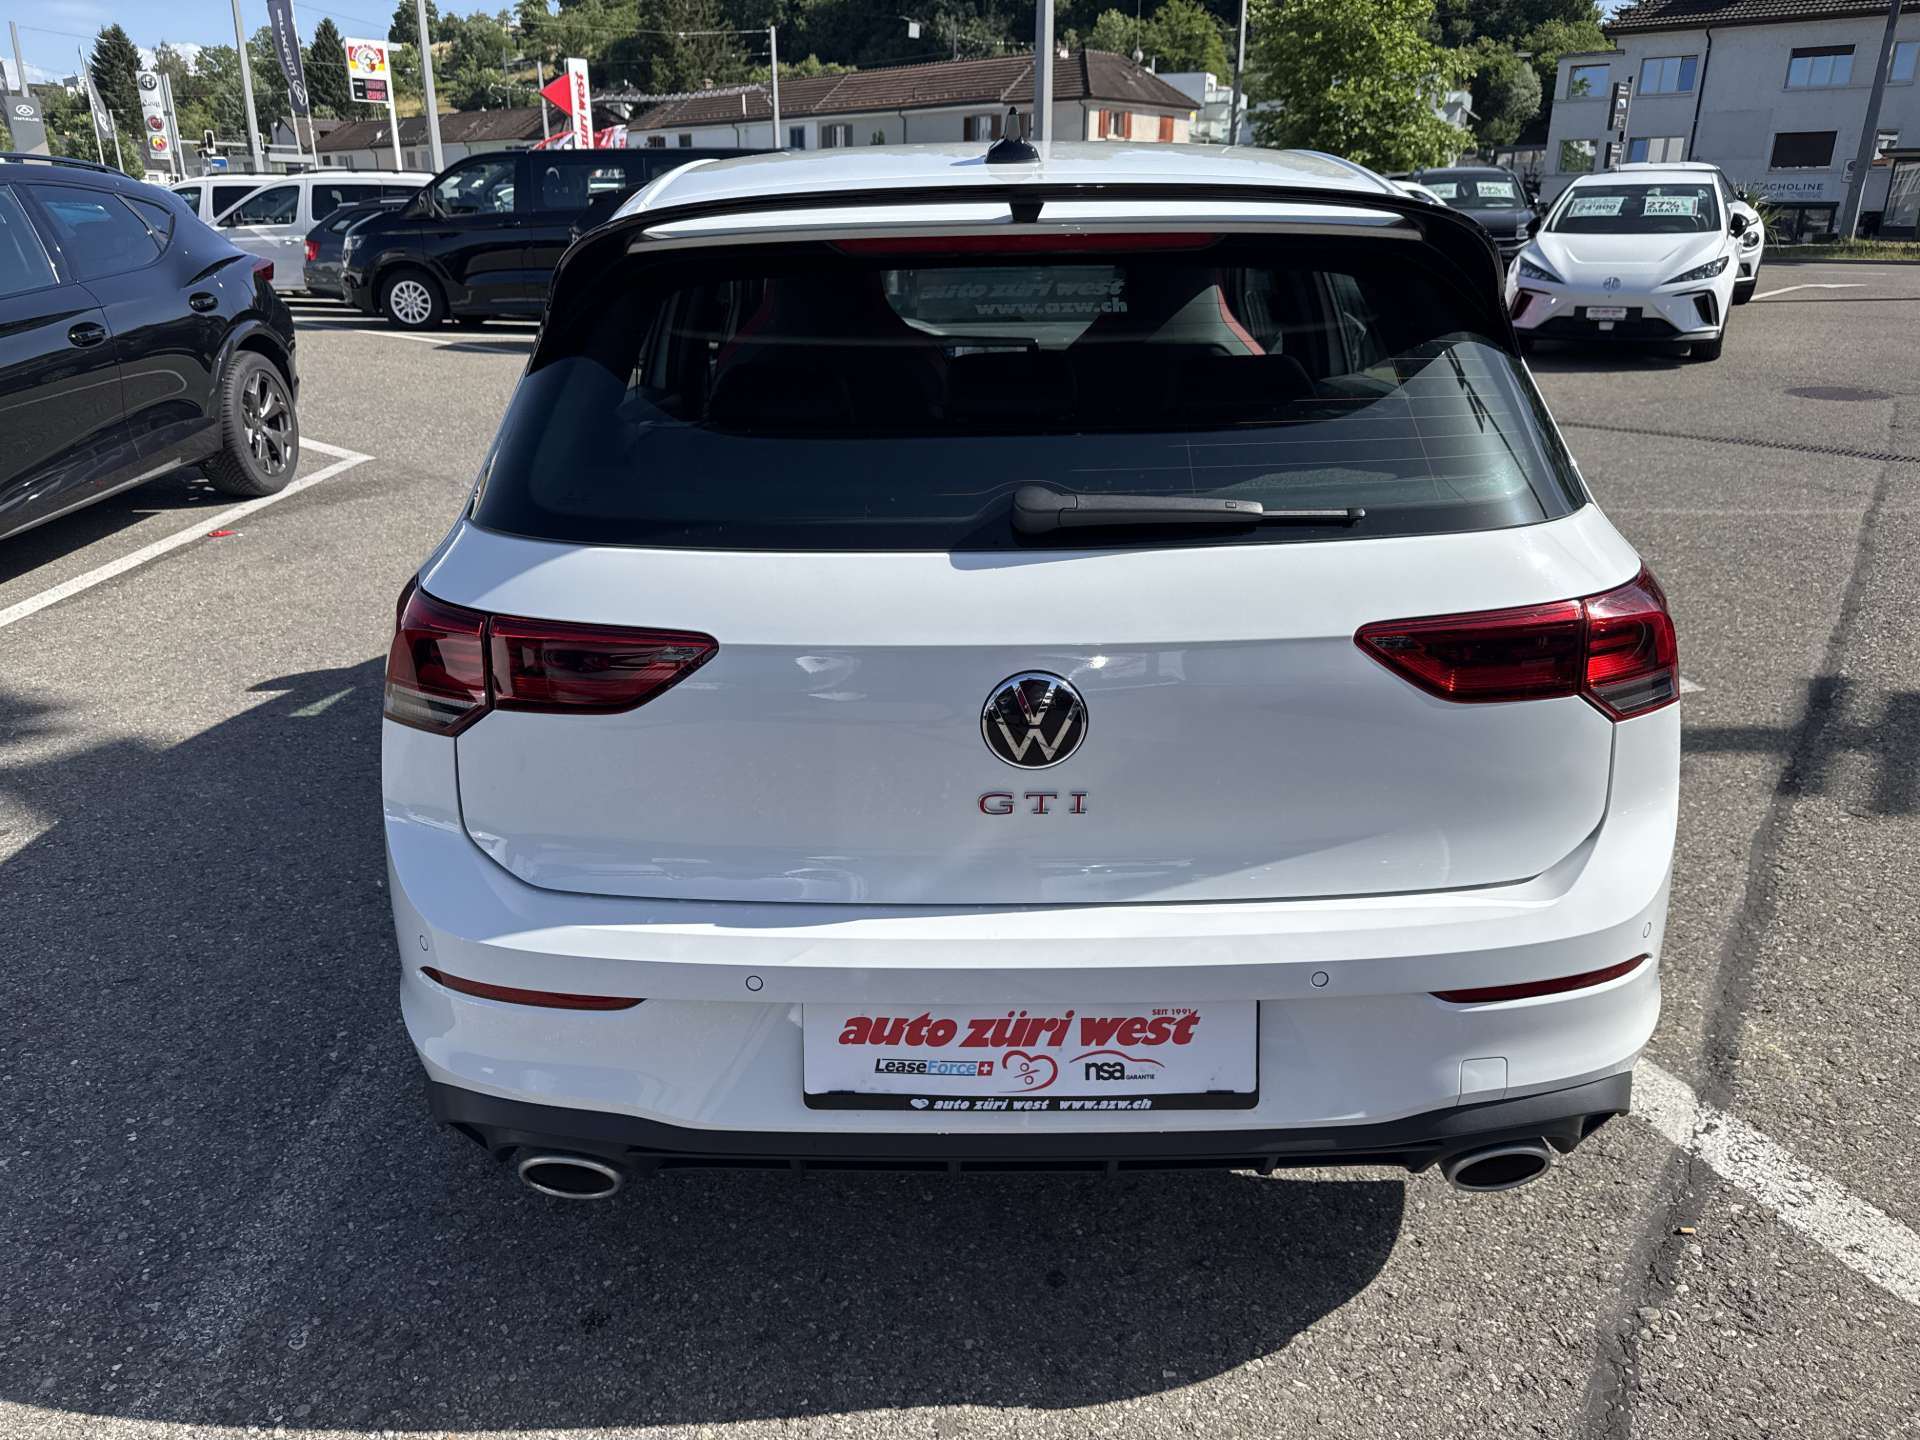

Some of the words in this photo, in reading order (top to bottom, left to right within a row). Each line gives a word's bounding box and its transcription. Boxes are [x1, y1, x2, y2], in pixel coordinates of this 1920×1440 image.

[975, 298, 1128, 314] www.azw.ch
[978, 791, 1089, 815] GTI
[1152, 1008, 1169, 1016] SEIT
[1171, 1008, 1193, 1016] 1991
[838, 1012, 958, 1047] auto
[958, 1009, 1075, 1048] züri
[1080, 1008, 1200, 1047] west
[875, 1058, 977, 1075] LeaseForce
[1085, 1062, 1126, 1081] nsa
[933, 1099, 970, 1110] auto
[973, 1097, 1009, 1110] züri
[1012, 1099, 1050, 1110] west
[1059, 1098, 1152, 1110] www.azw.ch
